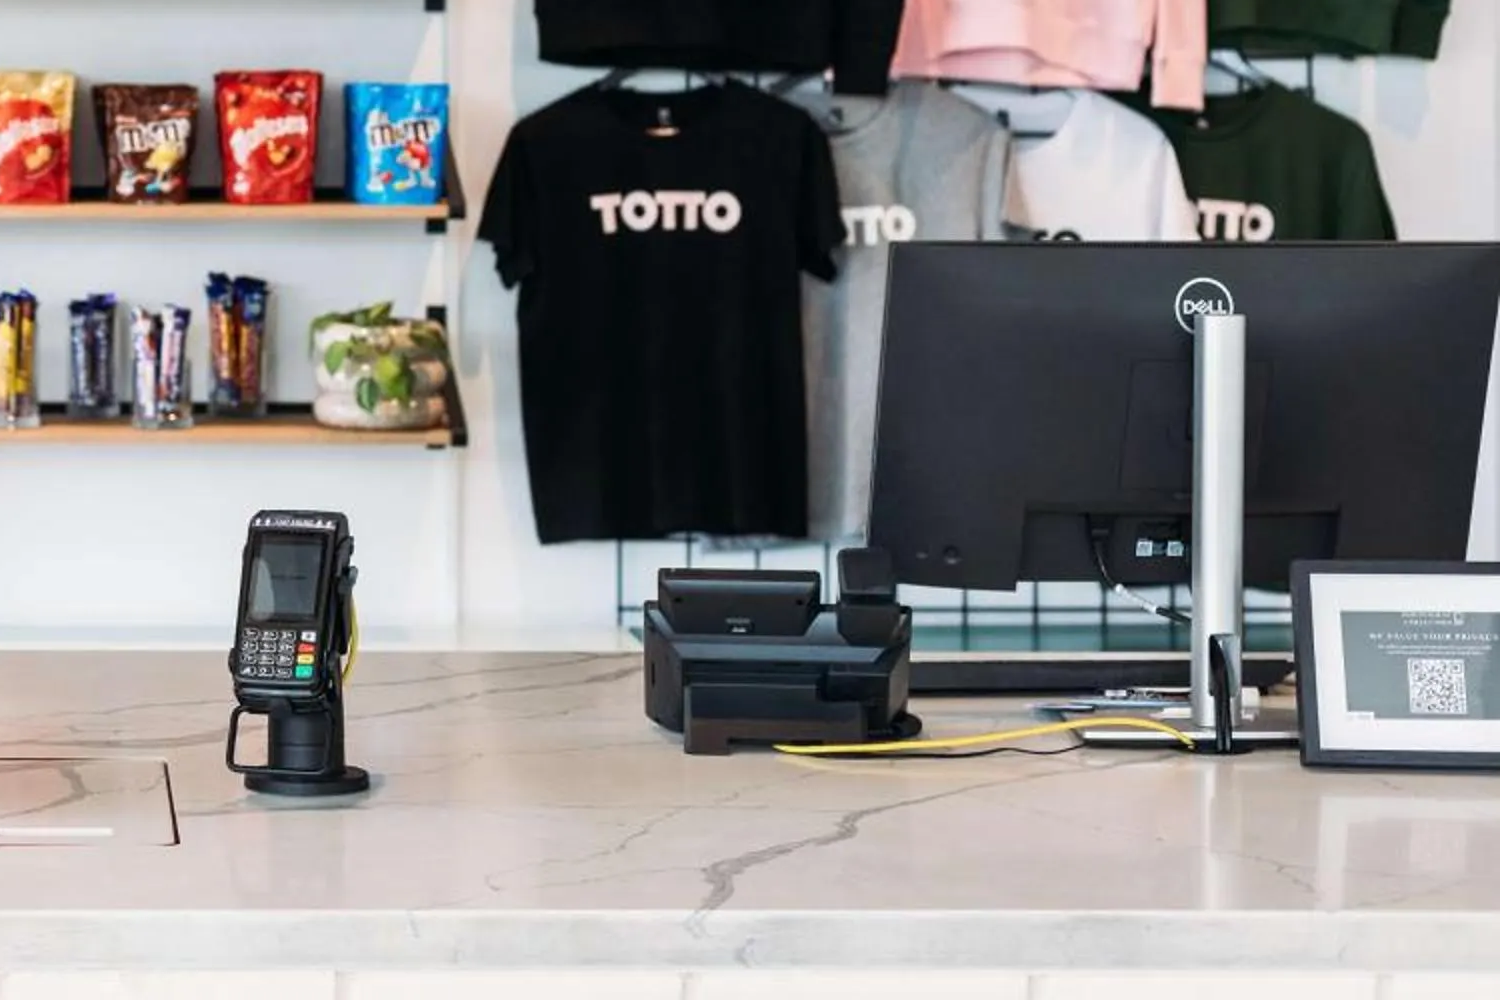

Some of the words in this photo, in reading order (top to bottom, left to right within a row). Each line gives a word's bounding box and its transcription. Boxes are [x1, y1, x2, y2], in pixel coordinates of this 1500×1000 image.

[590, 189, 742, 234] TOTTO
[840, 204, 917, 246] TTO
[1197, 198, 1275, 242] TTO
[1183, 299, 1227, 315] DELL
